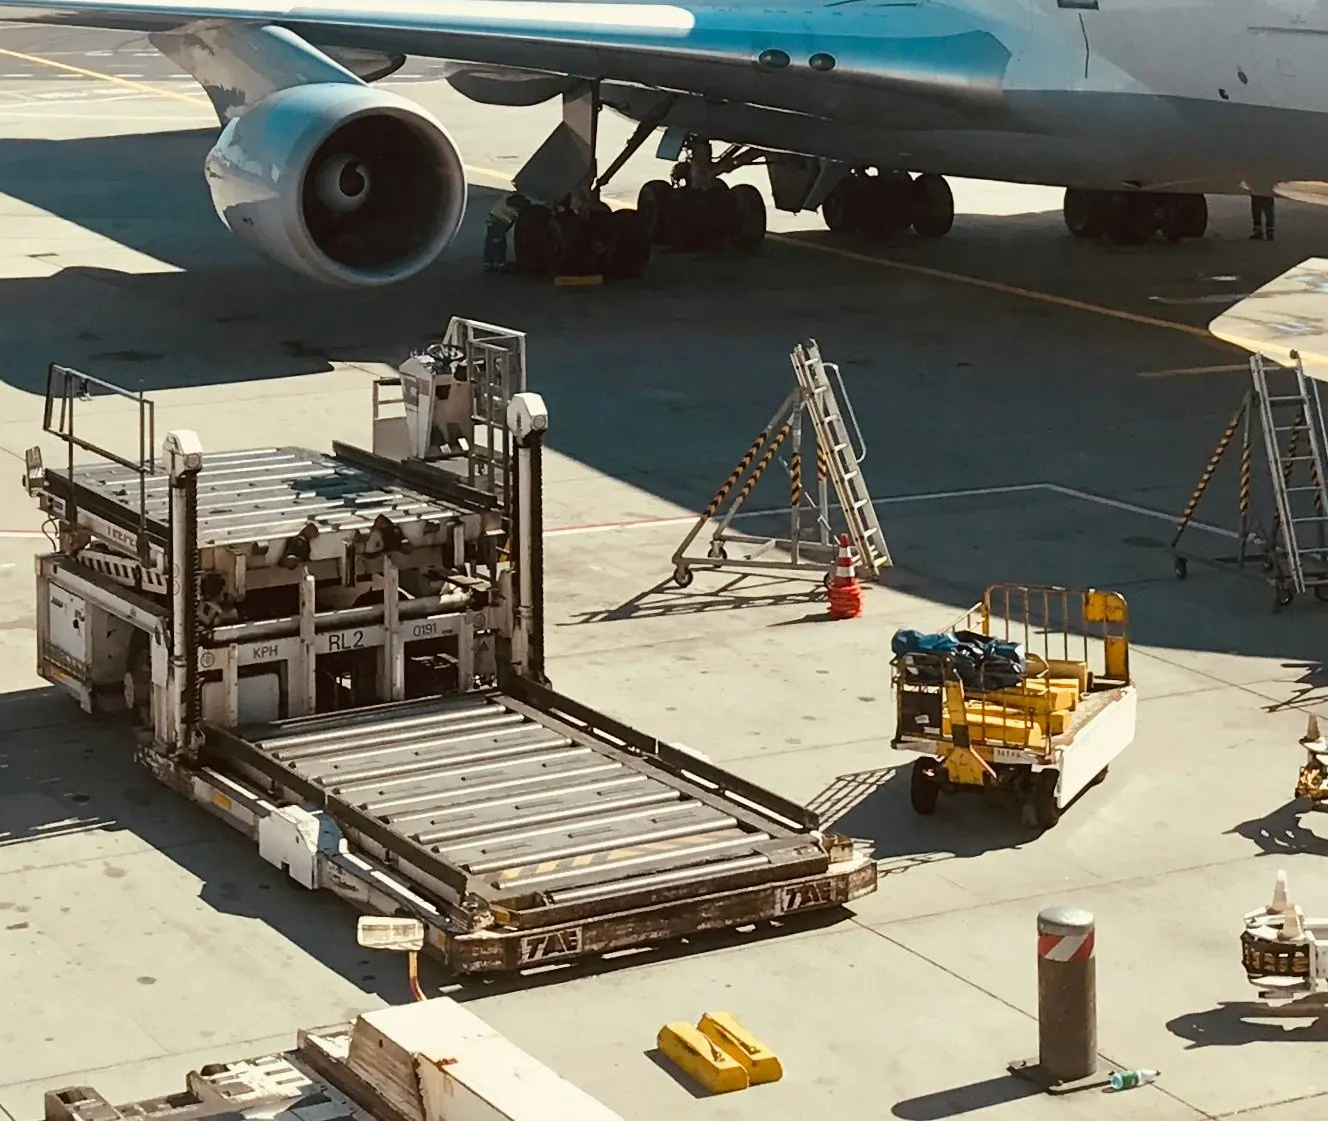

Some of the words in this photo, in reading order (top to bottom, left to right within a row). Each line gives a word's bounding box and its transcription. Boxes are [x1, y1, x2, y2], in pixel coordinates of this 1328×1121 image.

[253, 644, 278, 659] KPH
[328, 631, 364, 651] RL2
[413, 623, 437, 637] 0191
